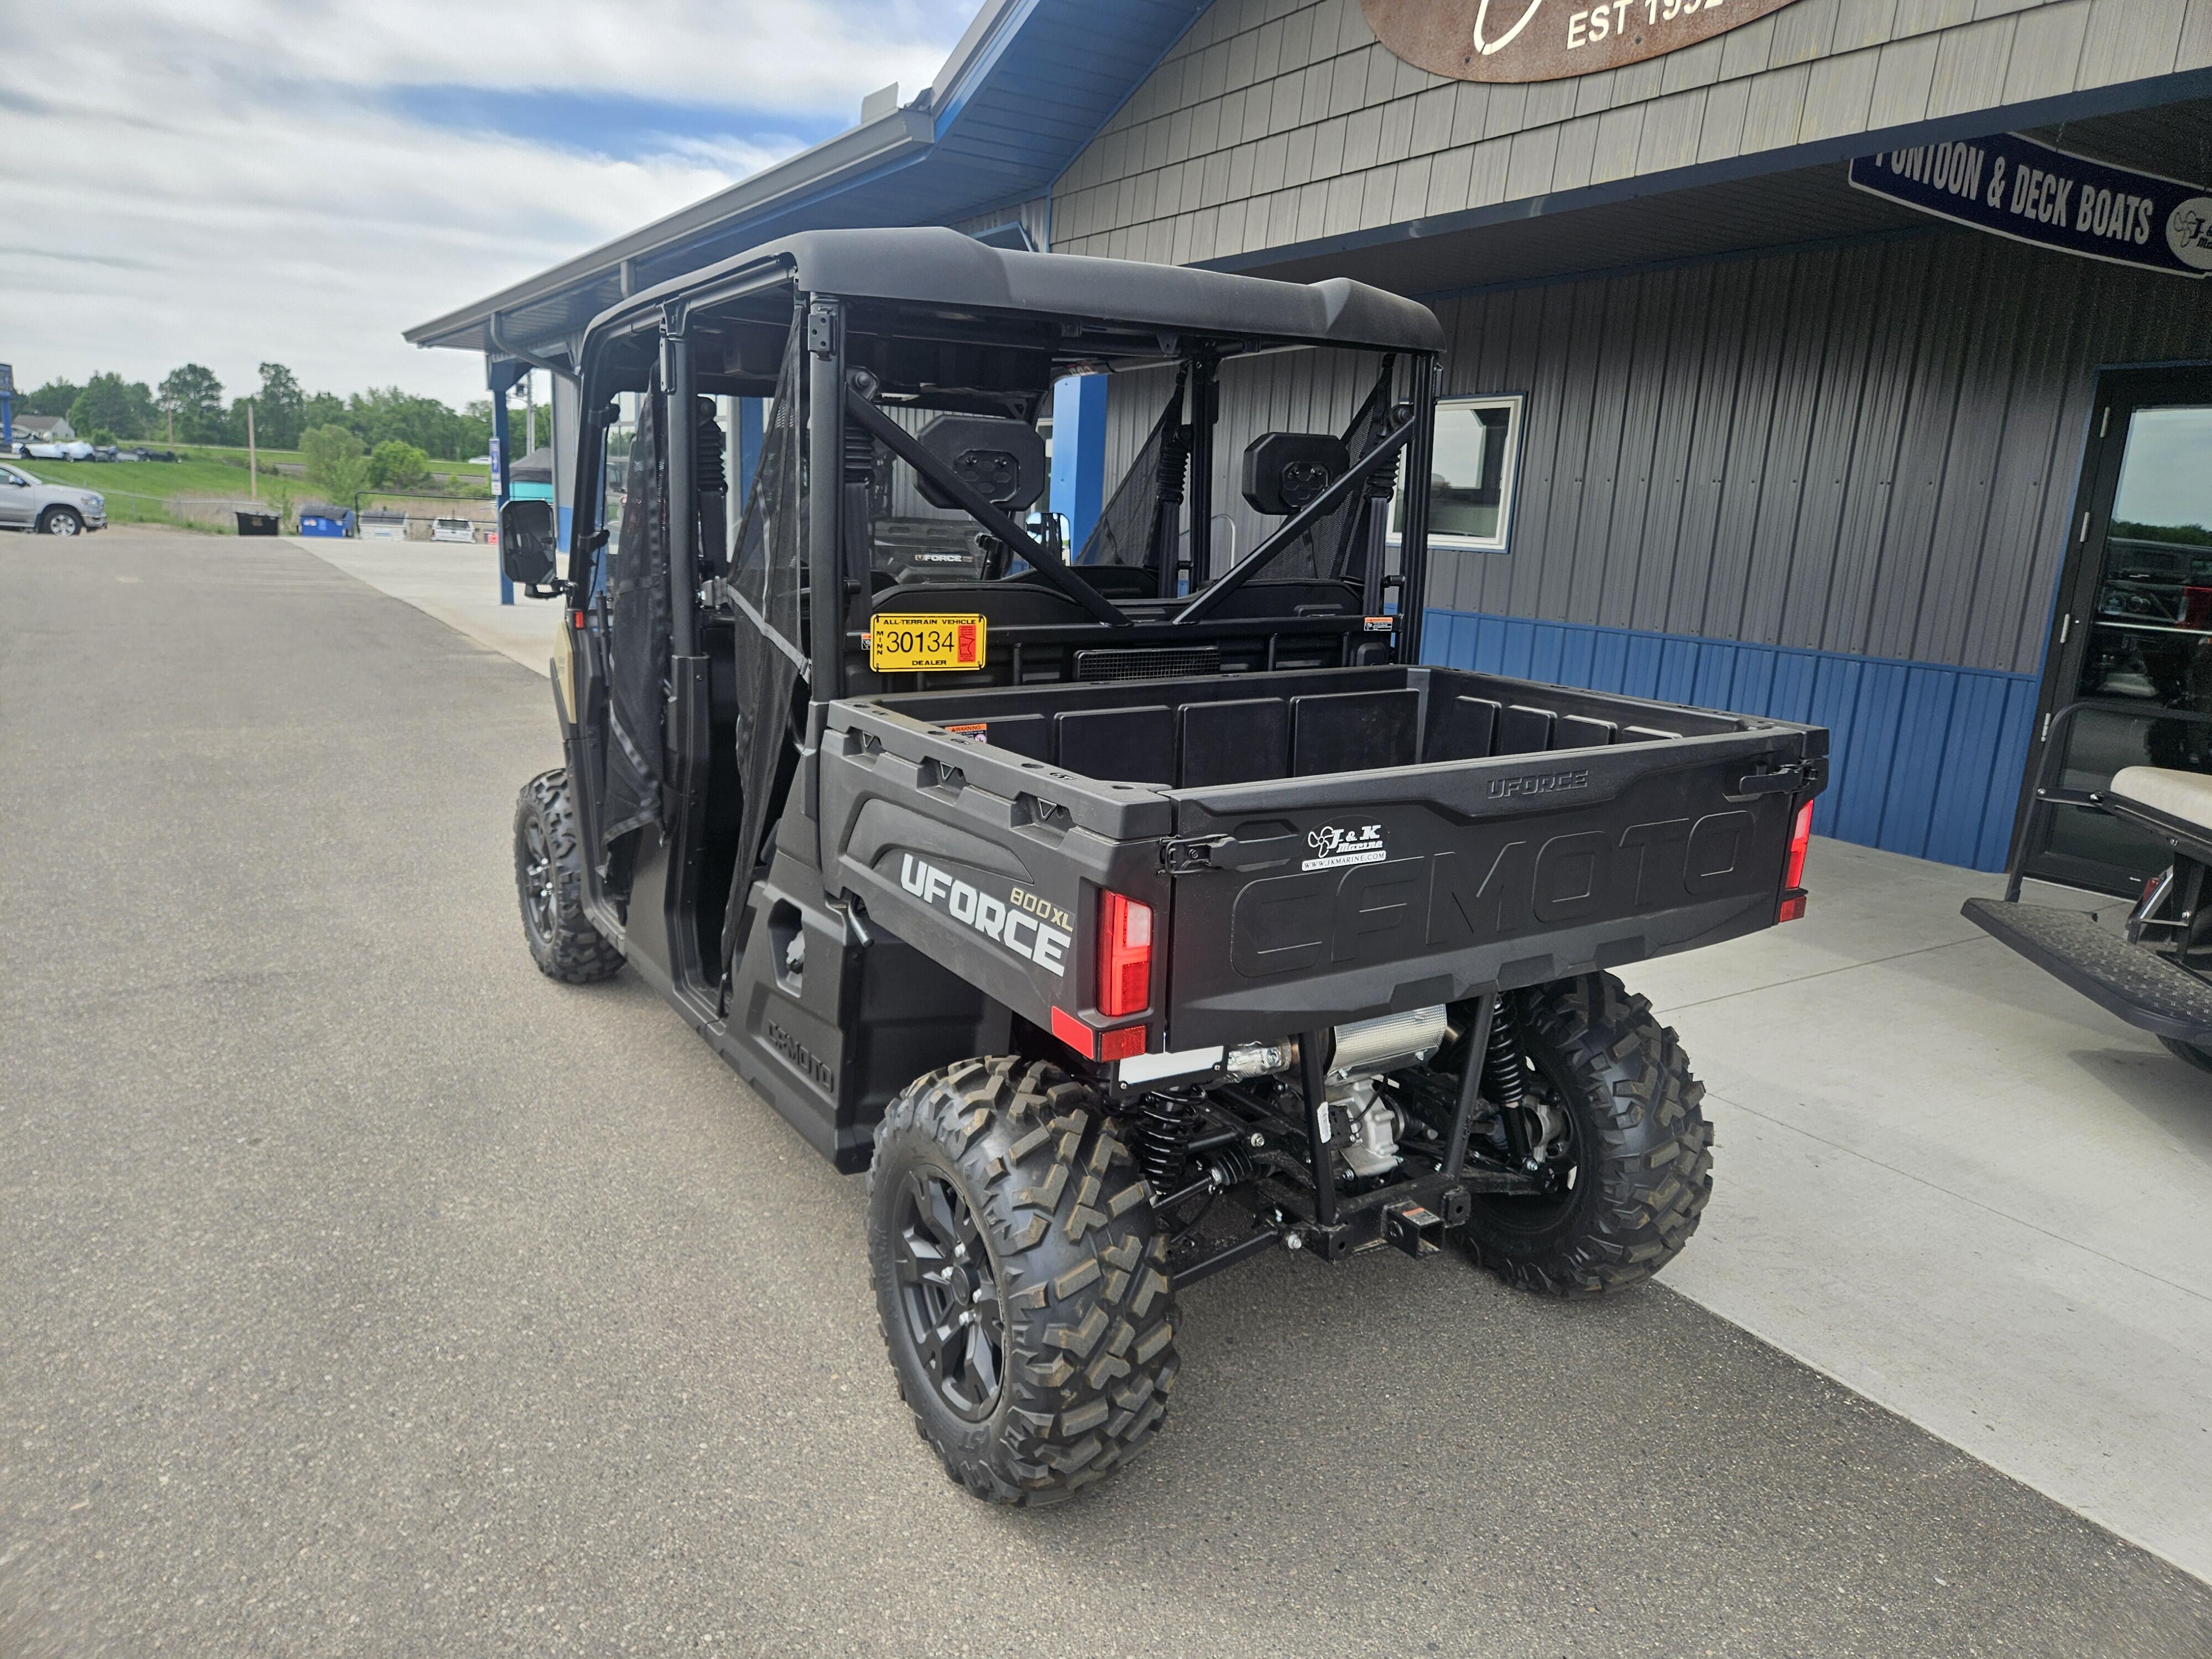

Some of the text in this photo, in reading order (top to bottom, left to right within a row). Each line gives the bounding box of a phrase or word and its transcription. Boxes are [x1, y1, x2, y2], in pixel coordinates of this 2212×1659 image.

[1567, 0, 1632, 50] EST
[1987, 156, 2006, 209] &
[2010, 164, 2074, 228] DECK
[2076, 184, 2153, 245] BOATS
[914, 554, 962, 562] UFORCE
[886, 631, 954, 653] 30134
[1486, 770, 1588, 799] UFORCE
[1345, 831, 1357, 842] &
[1359, 825, 1381, 841] K
[1304, 853, 1384, 869] WWW.JKMARINE.COM
[1231, 810, 1756, 978] CFMOTO
[901, 853, 1071, 978] UFORCE
[768, 1019, 834, 1093] CFMOTO
